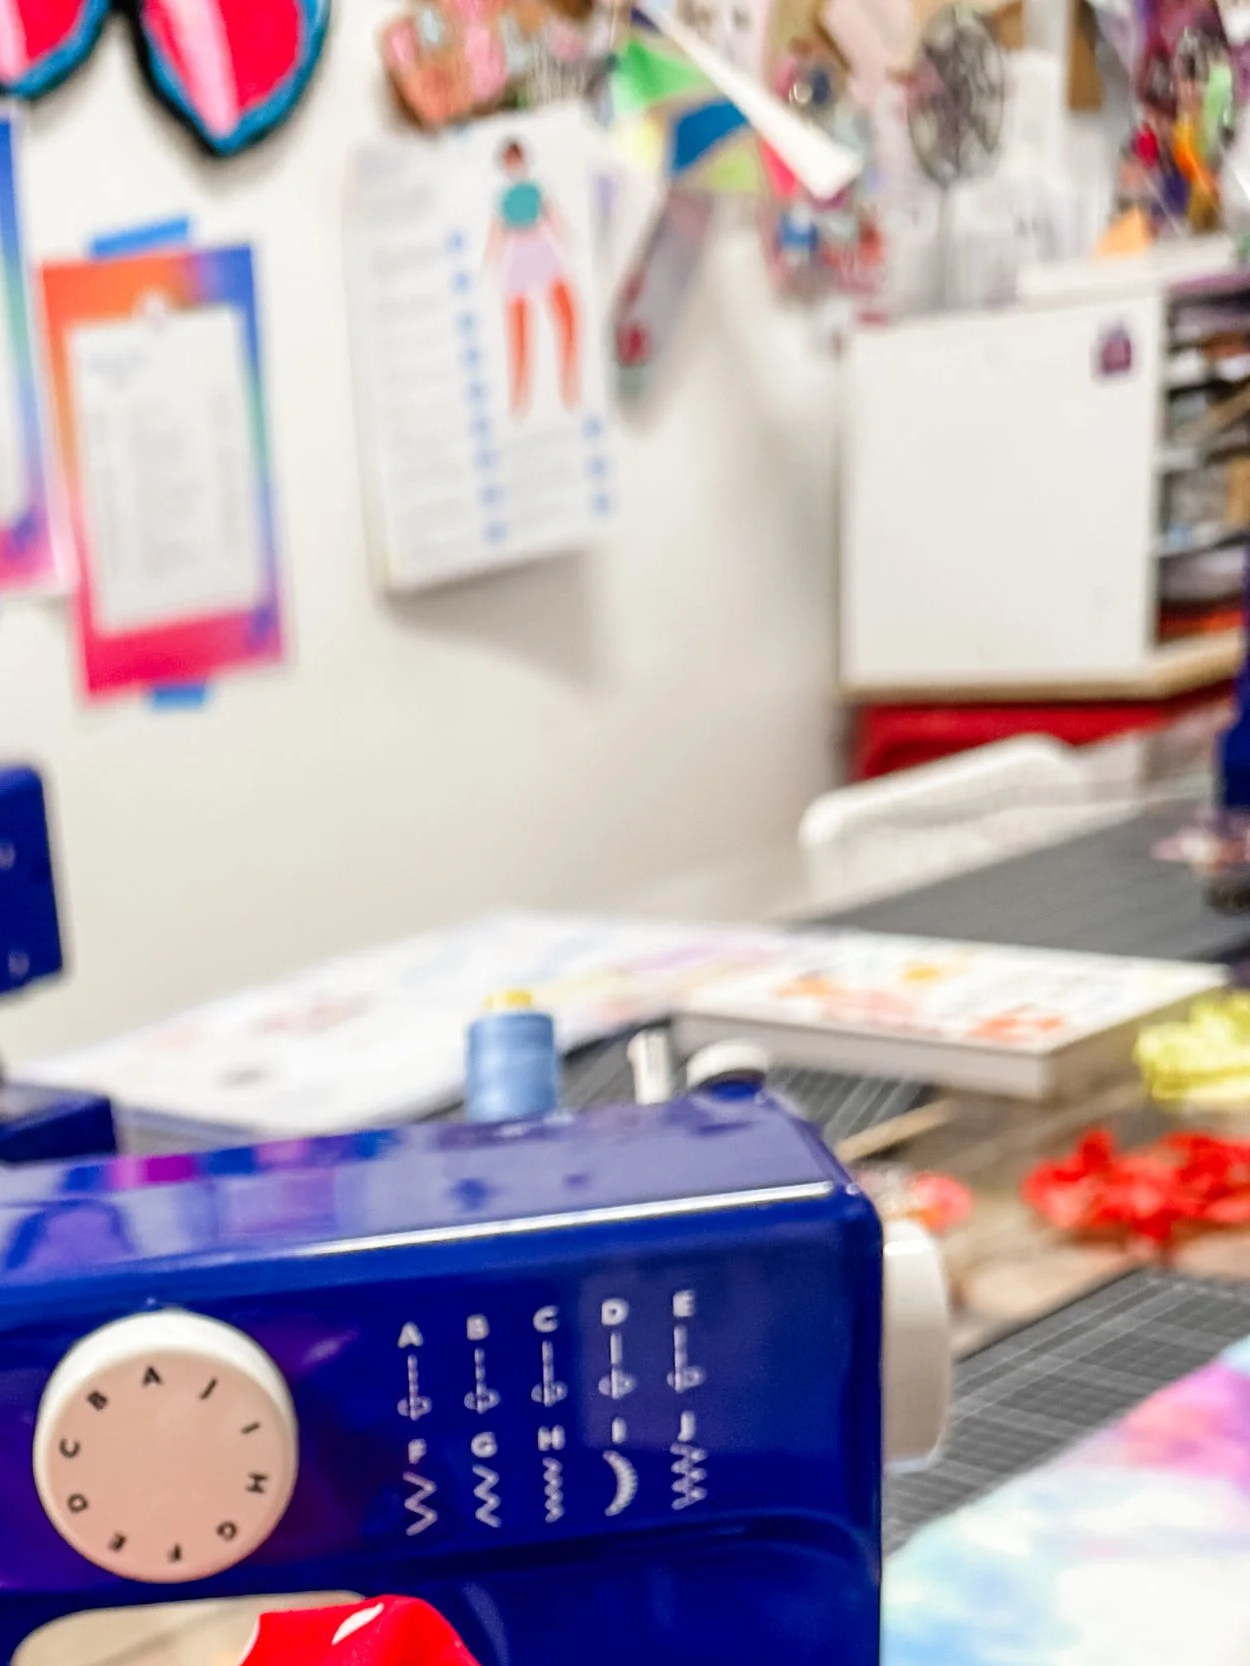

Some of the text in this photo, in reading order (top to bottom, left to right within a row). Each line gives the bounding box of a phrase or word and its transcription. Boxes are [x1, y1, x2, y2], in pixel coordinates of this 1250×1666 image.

[397, 1289, 696, 1348] A B C D E
[141, 1365, 163, 1388] A
[86, 1391, 109, 1413] B
[239, 1420, 262, 1436] I
[407, 1409, 696, 1465] F G H I J
[58, 1437, 82, 1459] C
[245, 1472, 269, 1495] H
